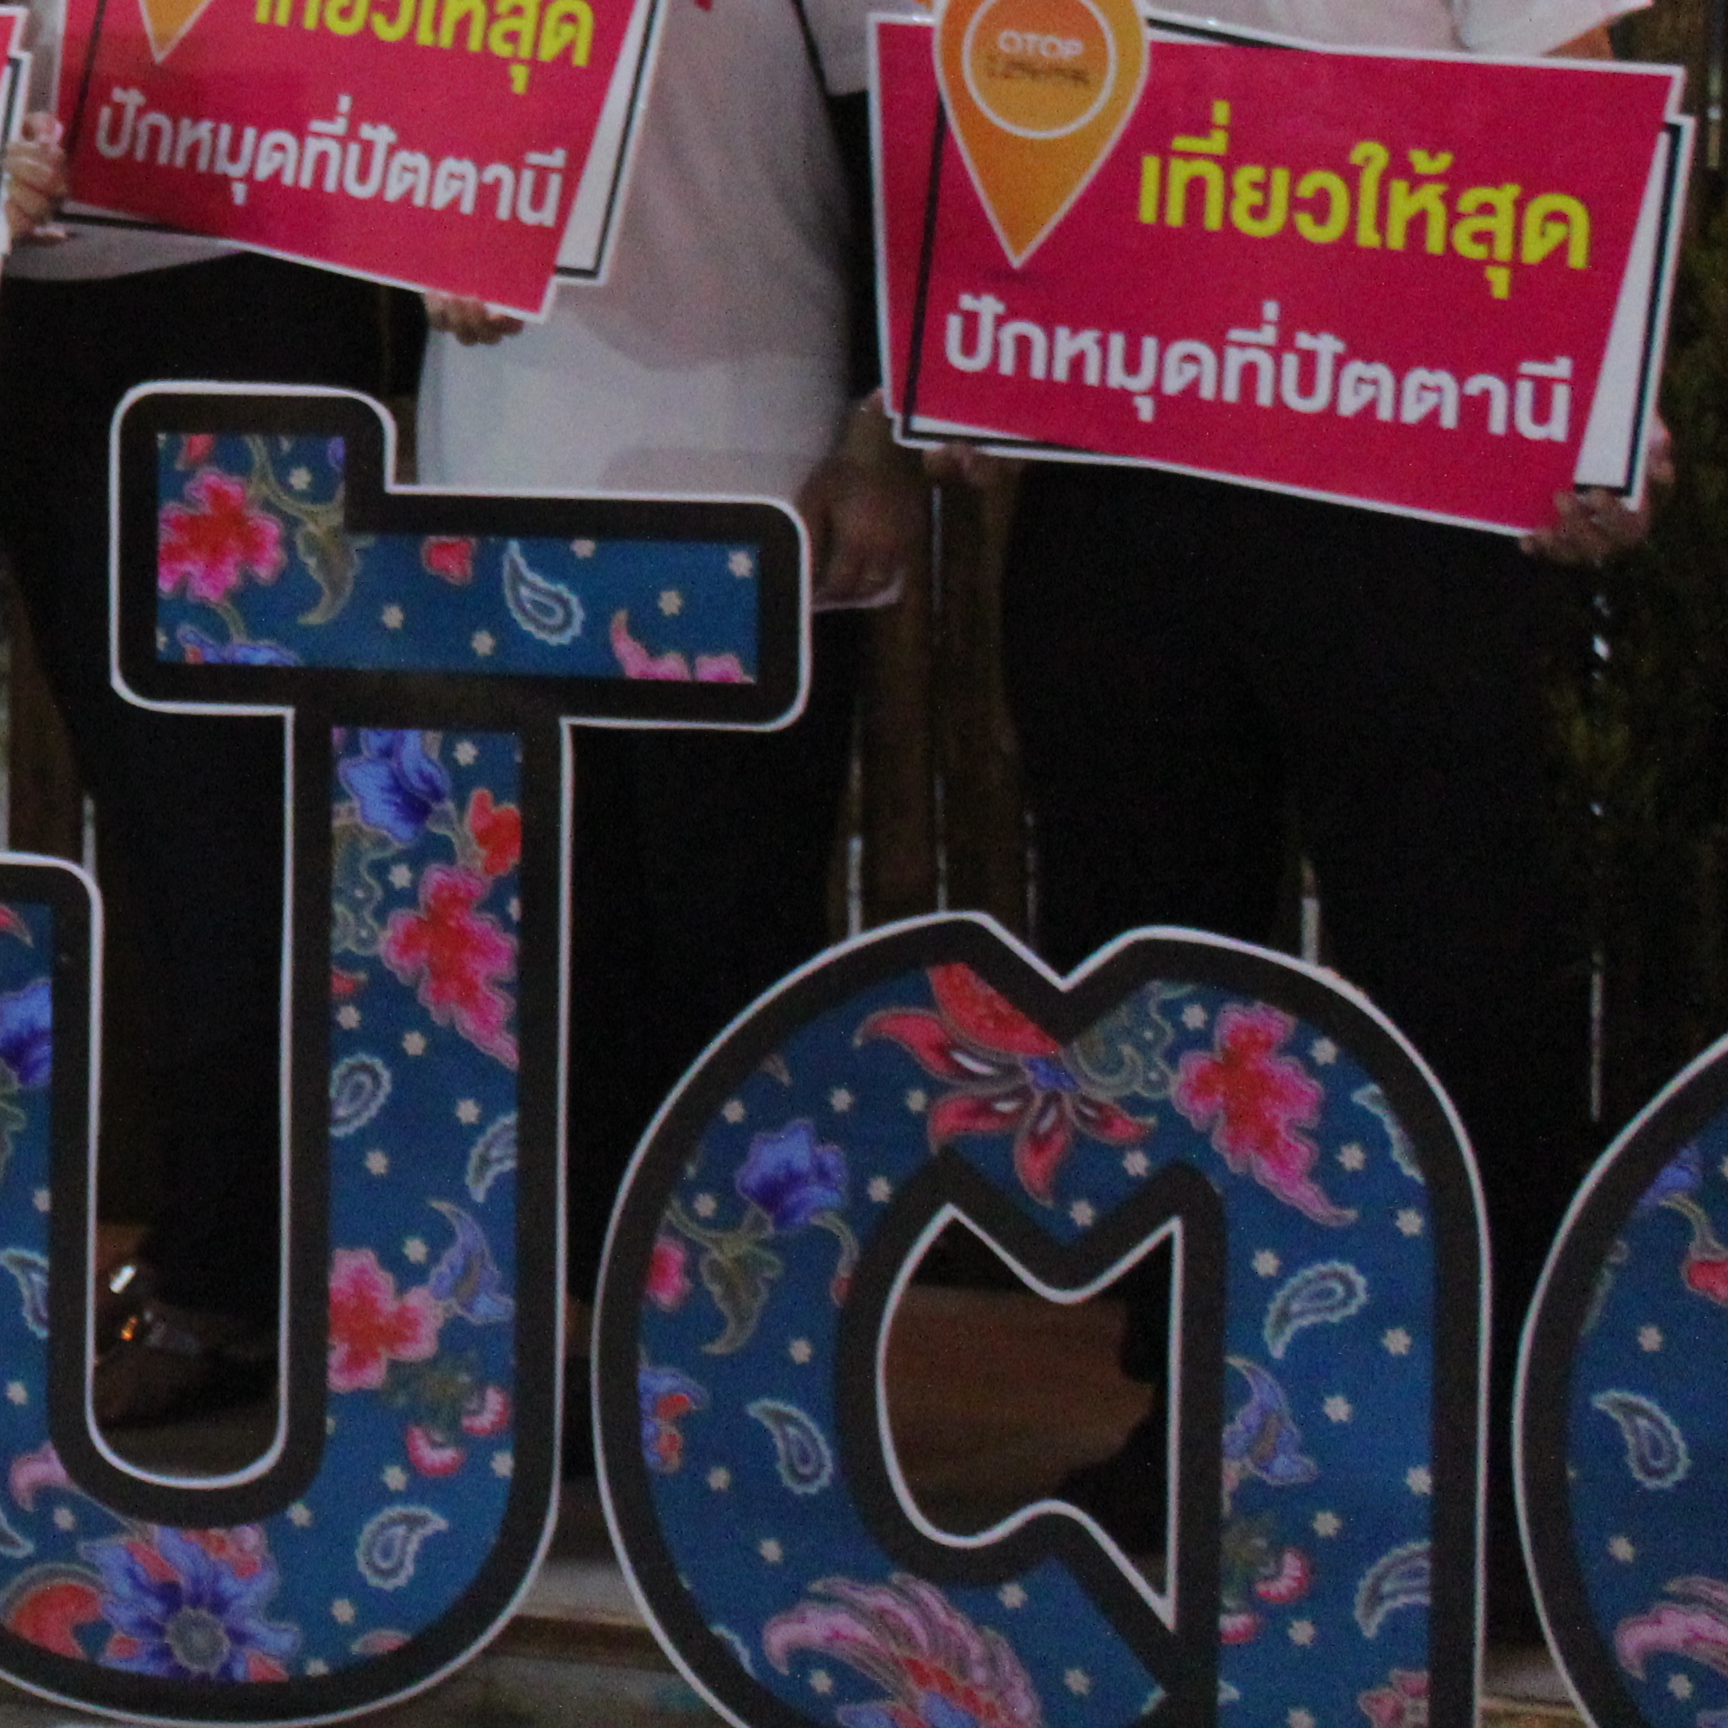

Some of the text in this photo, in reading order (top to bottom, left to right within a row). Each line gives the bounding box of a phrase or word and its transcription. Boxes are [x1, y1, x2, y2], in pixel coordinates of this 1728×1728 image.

[998, 29, 1084, 59] OTOP
[96, 88, 567, 229] ปักหมุดที่ปัตตานี
[1139, 99, 1591, 300] เที่ยวให้สุด
[945, 294, 1573, 443] ปักหมุดที่ปัตตานี
